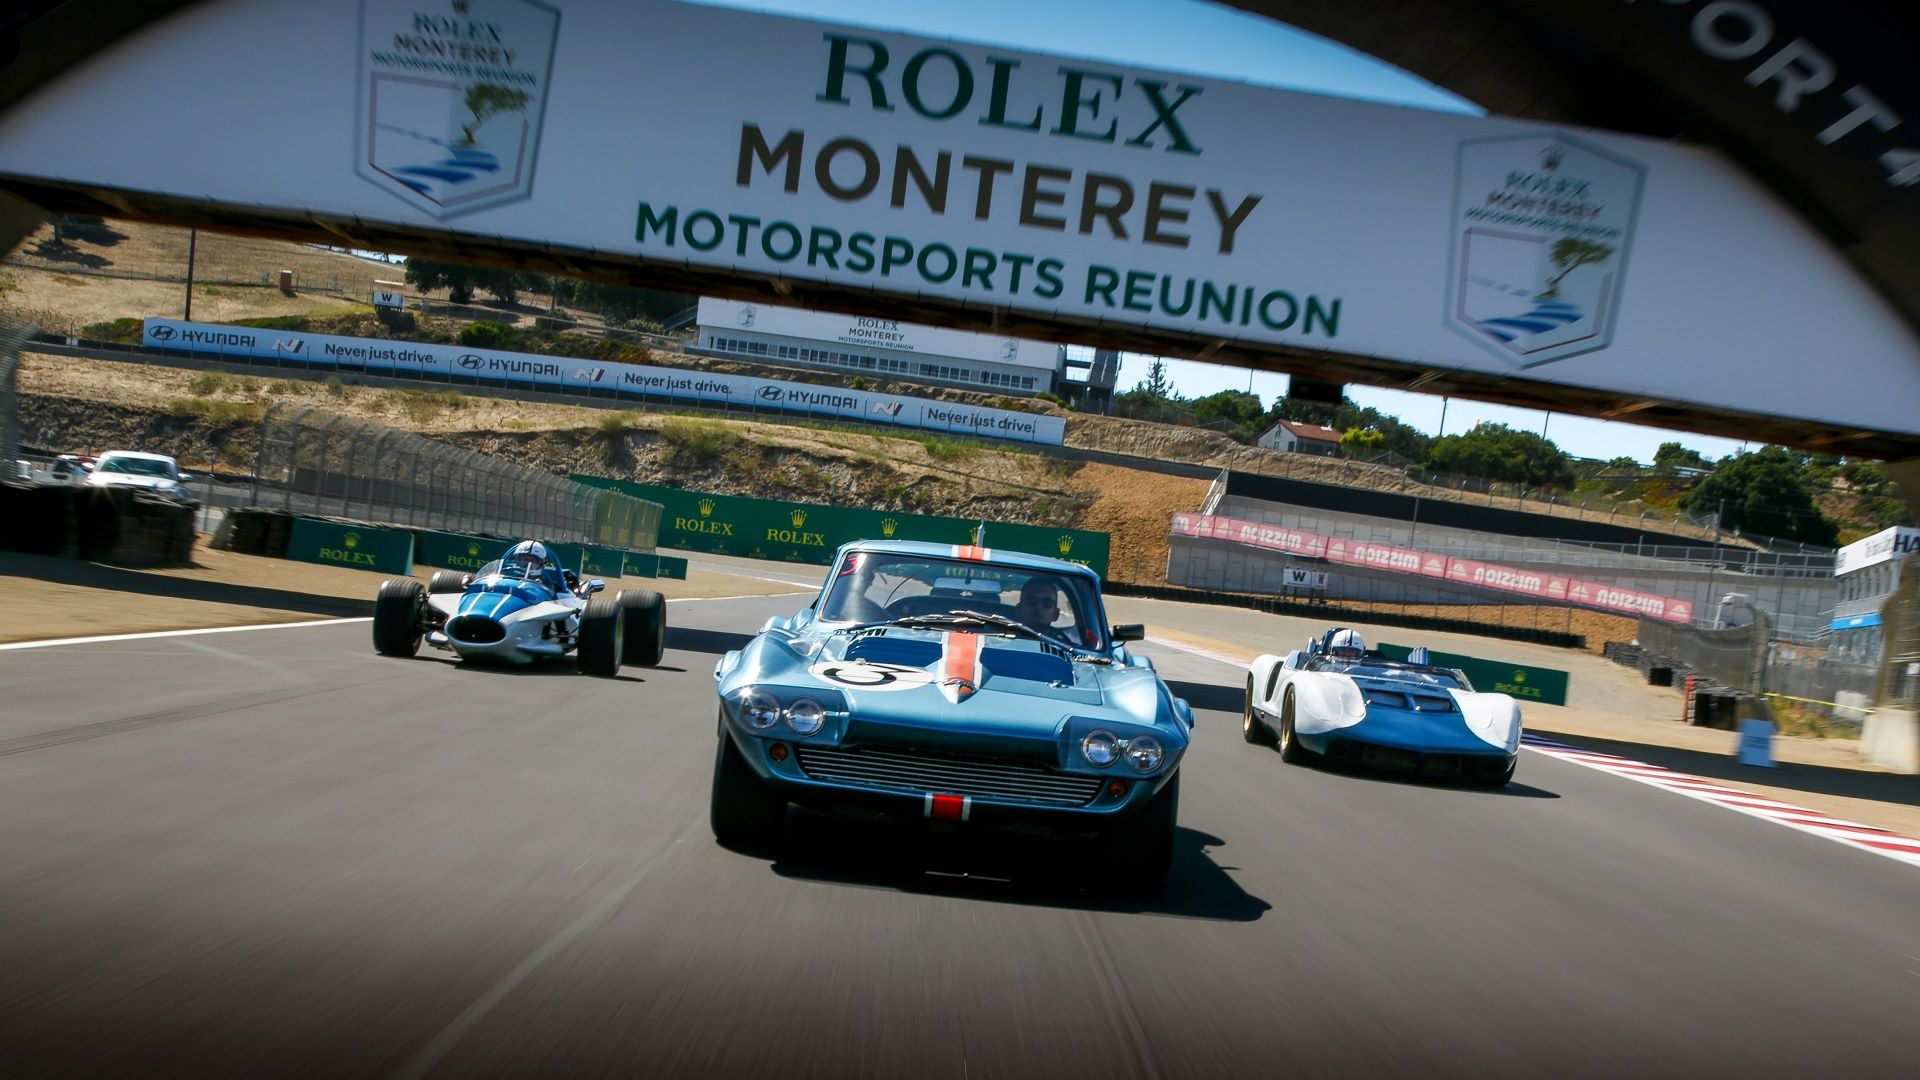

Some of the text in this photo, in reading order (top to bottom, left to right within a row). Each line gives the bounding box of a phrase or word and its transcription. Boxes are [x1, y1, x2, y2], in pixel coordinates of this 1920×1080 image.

[815, 32, 1204, 156] ROLEX
[735, 121, 1263, 256] MONTEREY
[634, 201, 1342, 338] MOTORSPORTS REUNION
[382, 293, 393, 302] W
[858, 318, 898, 331] ROLEX
[182, 330, 256, 348] HYUNDAI
[838, 336, 914, 350] MOTORSPORTS REUNION
[848, 328, 905, 341] MONTEREY
[325, 344, 437, 364] Never just drive.
[489, 358, 559, 377] HYUNDAI
[624, 372, 732, 395] Never just drive.
[788, 390, 857, 410] HYUNDAI
[927, 408, 1035, 434] Never just drive.
[675, 517, 733, 536] ROLEX
[767, 529, 826, 547] ROLEX
[319, 548, 376, 566] ROLEX
[1293, 571, 1306, 582] W
